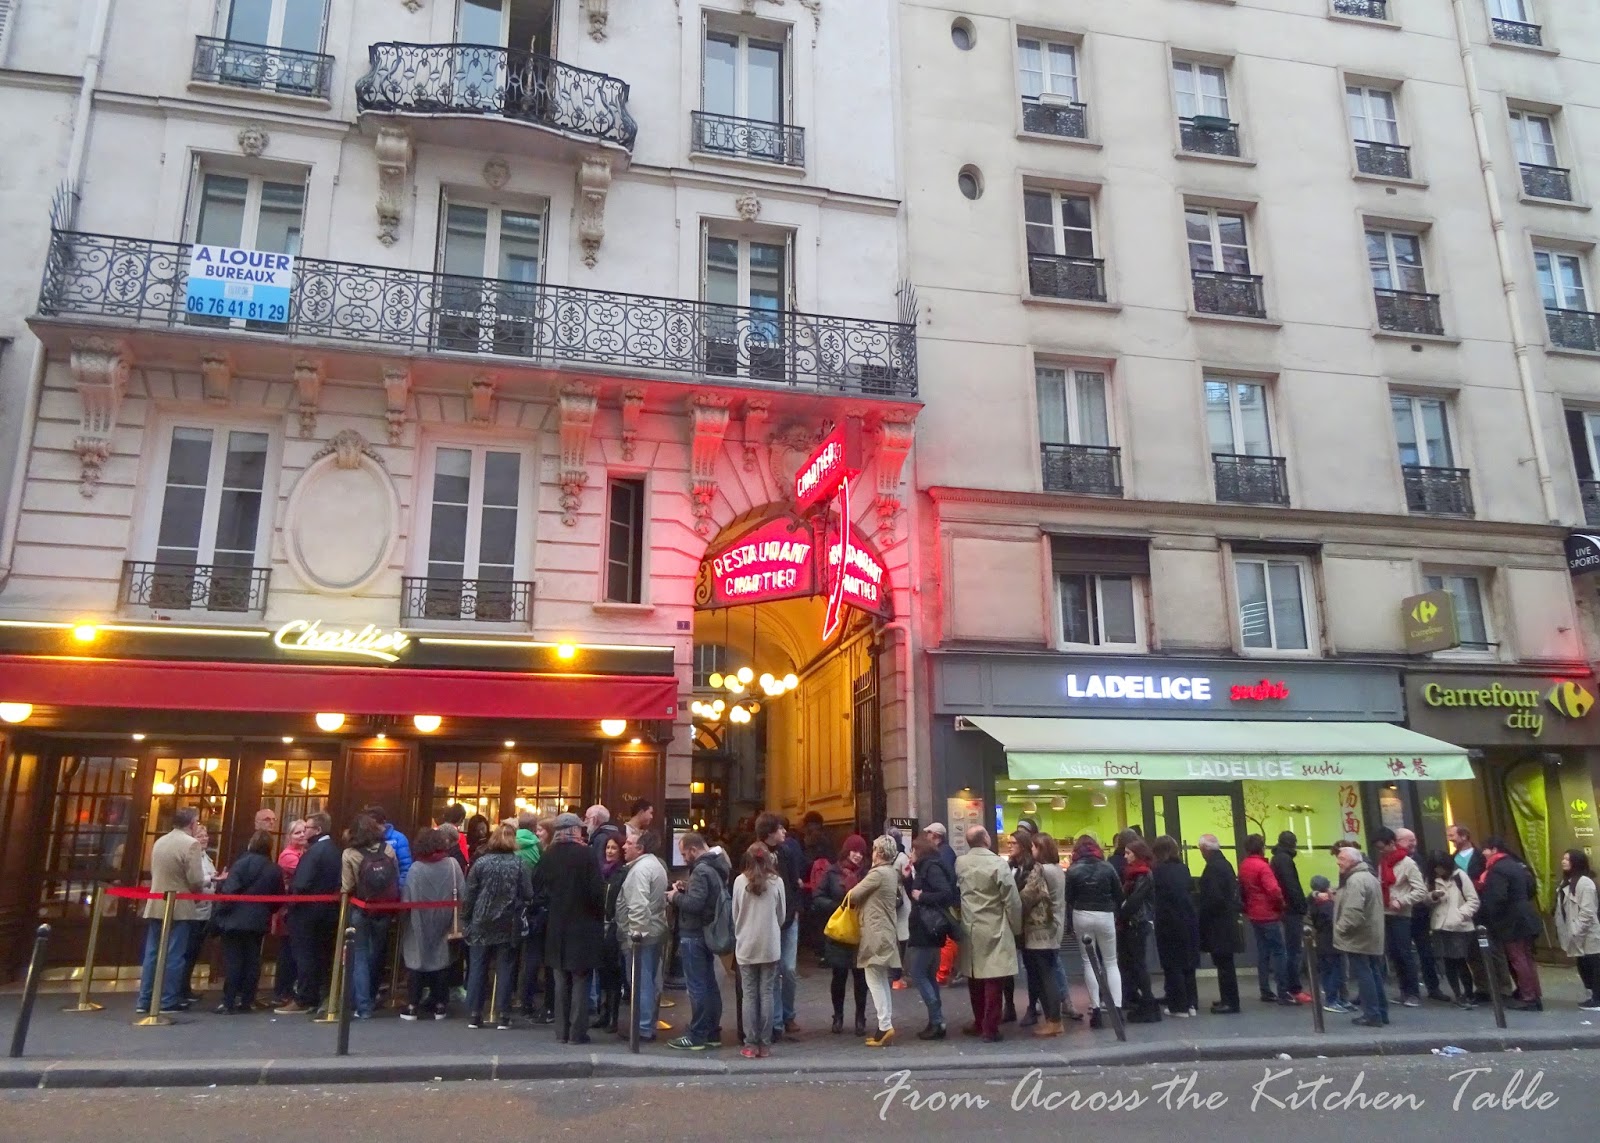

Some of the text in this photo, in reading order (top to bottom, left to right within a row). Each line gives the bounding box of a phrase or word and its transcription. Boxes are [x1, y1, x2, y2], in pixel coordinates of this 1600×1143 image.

[196, 247, 290, 271] A LOUER
[205, 264, 276, 284] BUREAUX
[187, 295, 285, 320] 06 76 41 81 29
[713, 541, 811, 578] RESTAURANT
[1570, 554, 1600, 569] SPORTS
[1575, 546, 1592, 558] LIVE
[725, 568, 797, 596] CHARTIER
[1067, 674, 1211, 700] LADELICE
[1424, 682, 1540, 708] Carrefour
[1507, 709, 1543, 738] city
[1058, 760, 1142, 777] Asian food
[1185, 760, 1344, 777] LADELICE sushi
